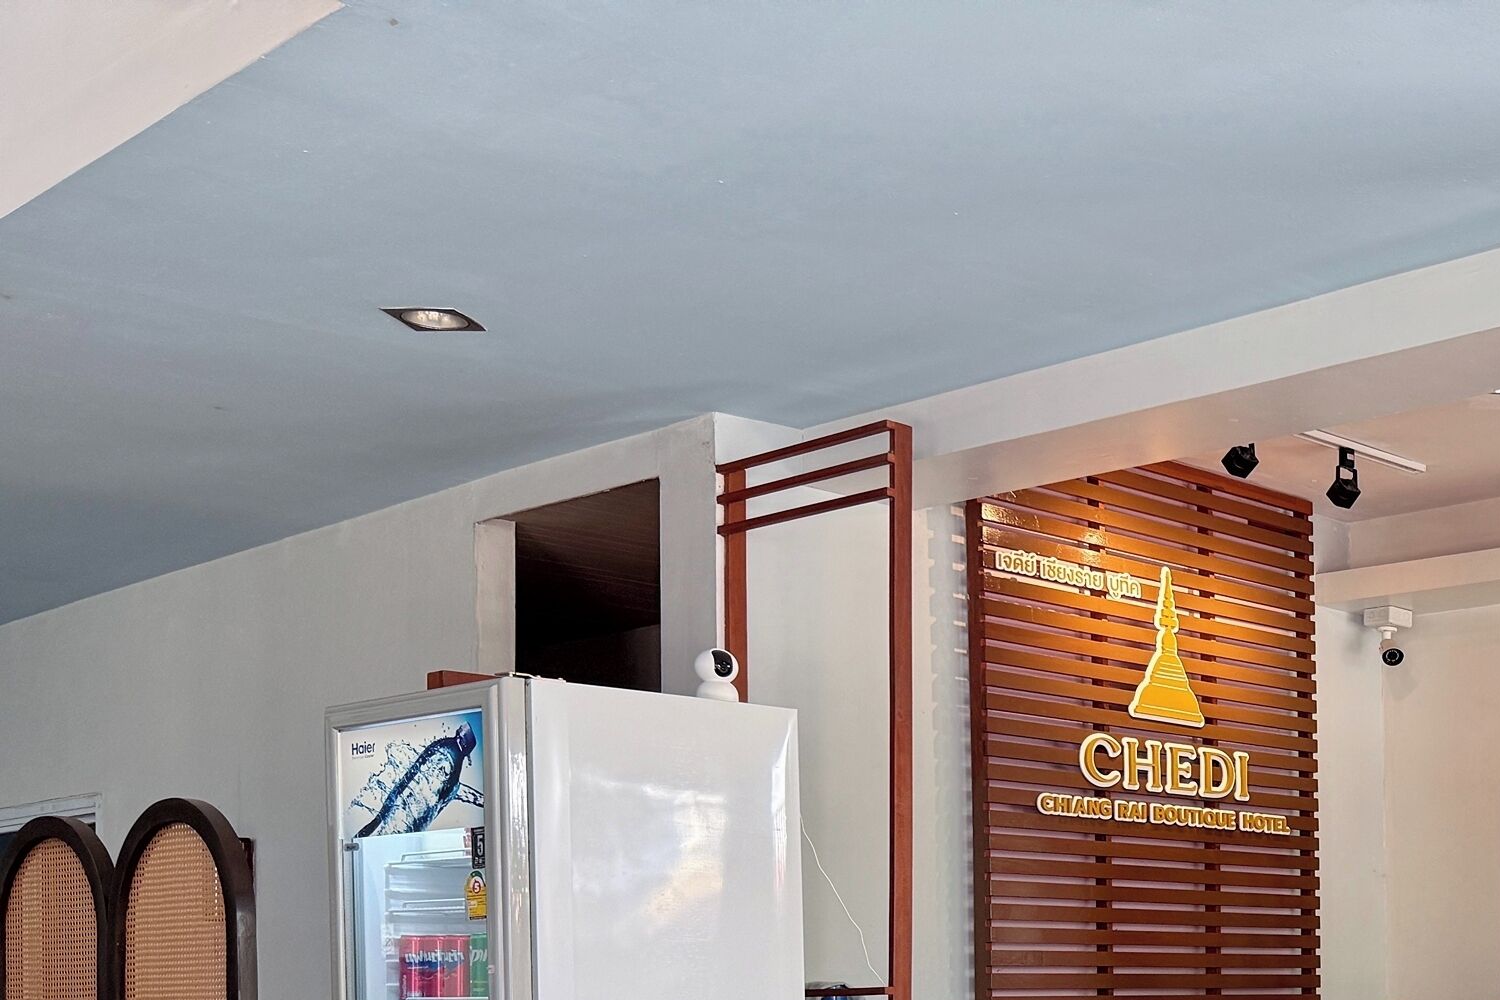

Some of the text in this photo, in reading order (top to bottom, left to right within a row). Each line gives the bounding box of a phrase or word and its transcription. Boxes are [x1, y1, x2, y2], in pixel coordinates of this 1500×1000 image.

[1040, 557, 1104, 590] เชียงราย
[351, 740, 375, 755] Haier
[1079, 733, 1250, 801] CHEDI
[1037, 792, 1291, 835] CHIANG RAI BOUTIQUE HOTEL
